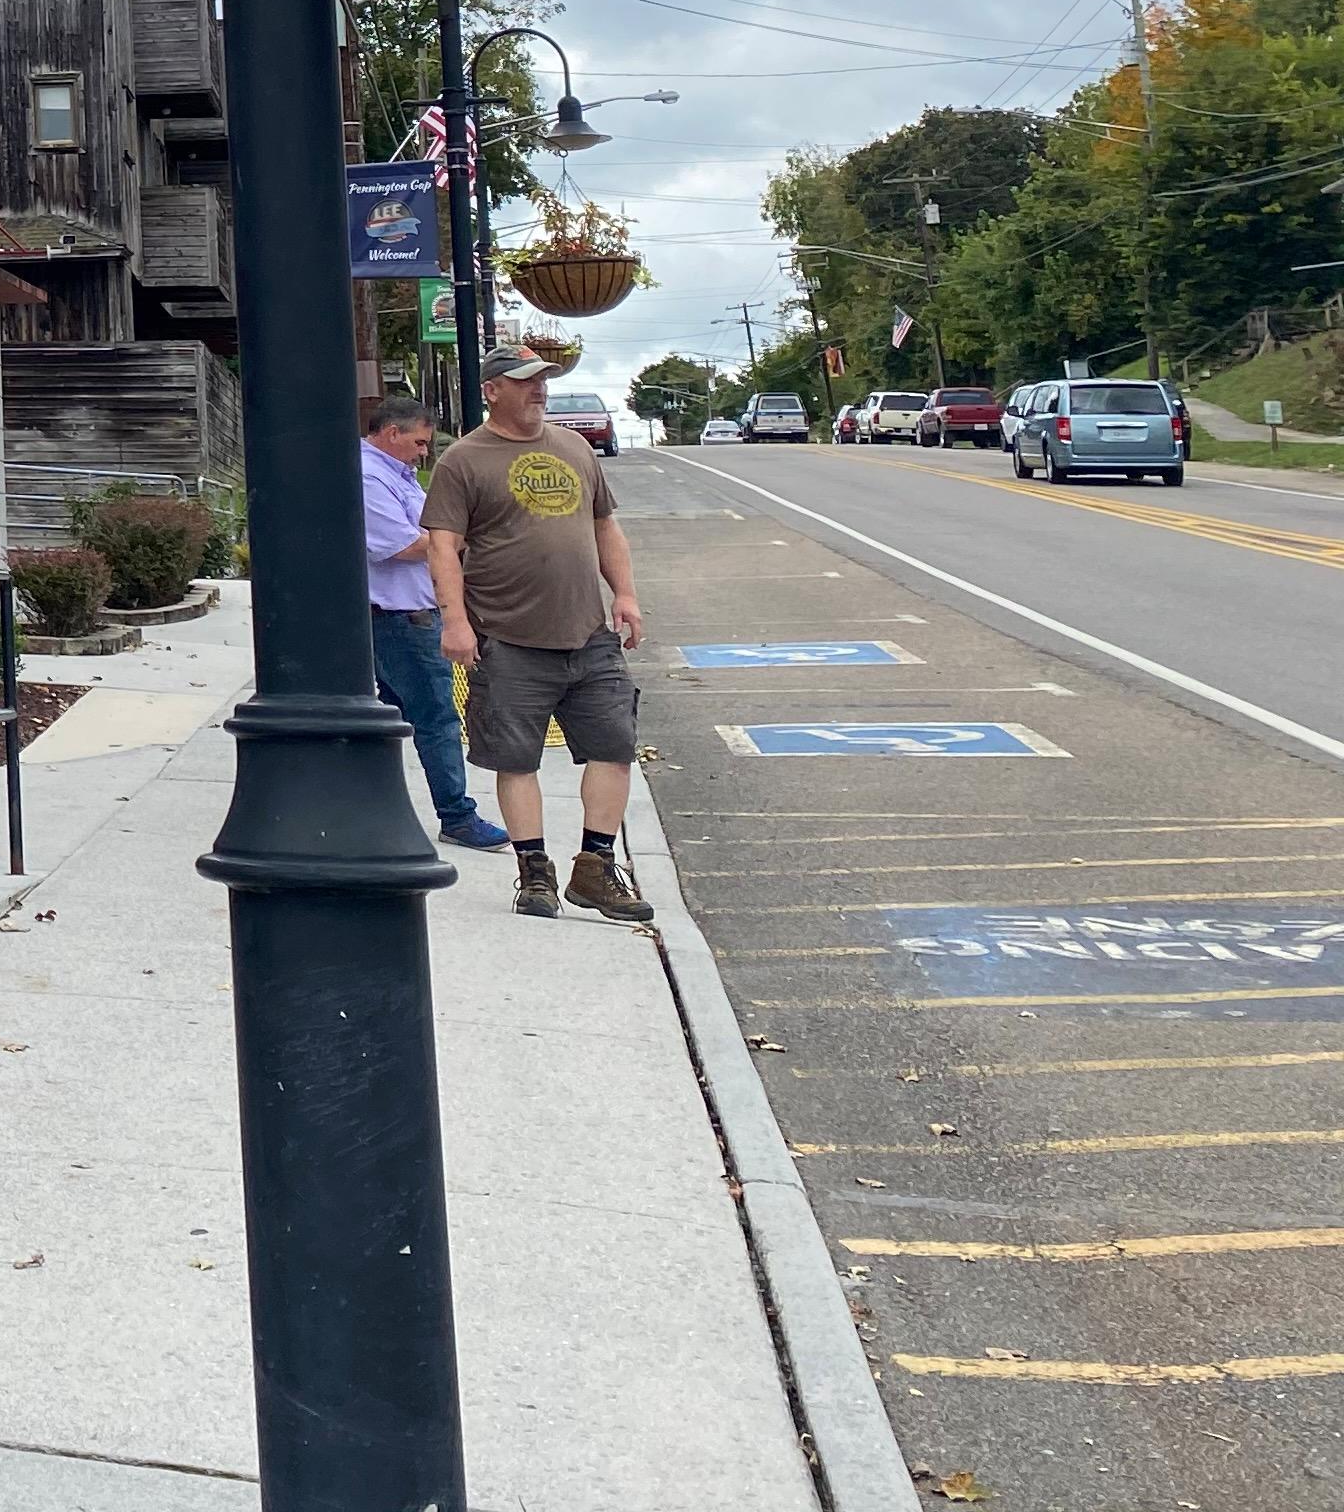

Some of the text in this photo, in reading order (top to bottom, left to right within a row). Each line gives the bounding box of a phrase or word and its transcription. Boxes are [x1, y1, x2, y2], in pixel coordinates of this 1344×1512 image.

[348, 179, 432, 196] Pennington Gap
[373, 203, 402, 219] LEE
[369, 248, 420, 261] Welcome!
[514, 473, 578, 494] Rattler
